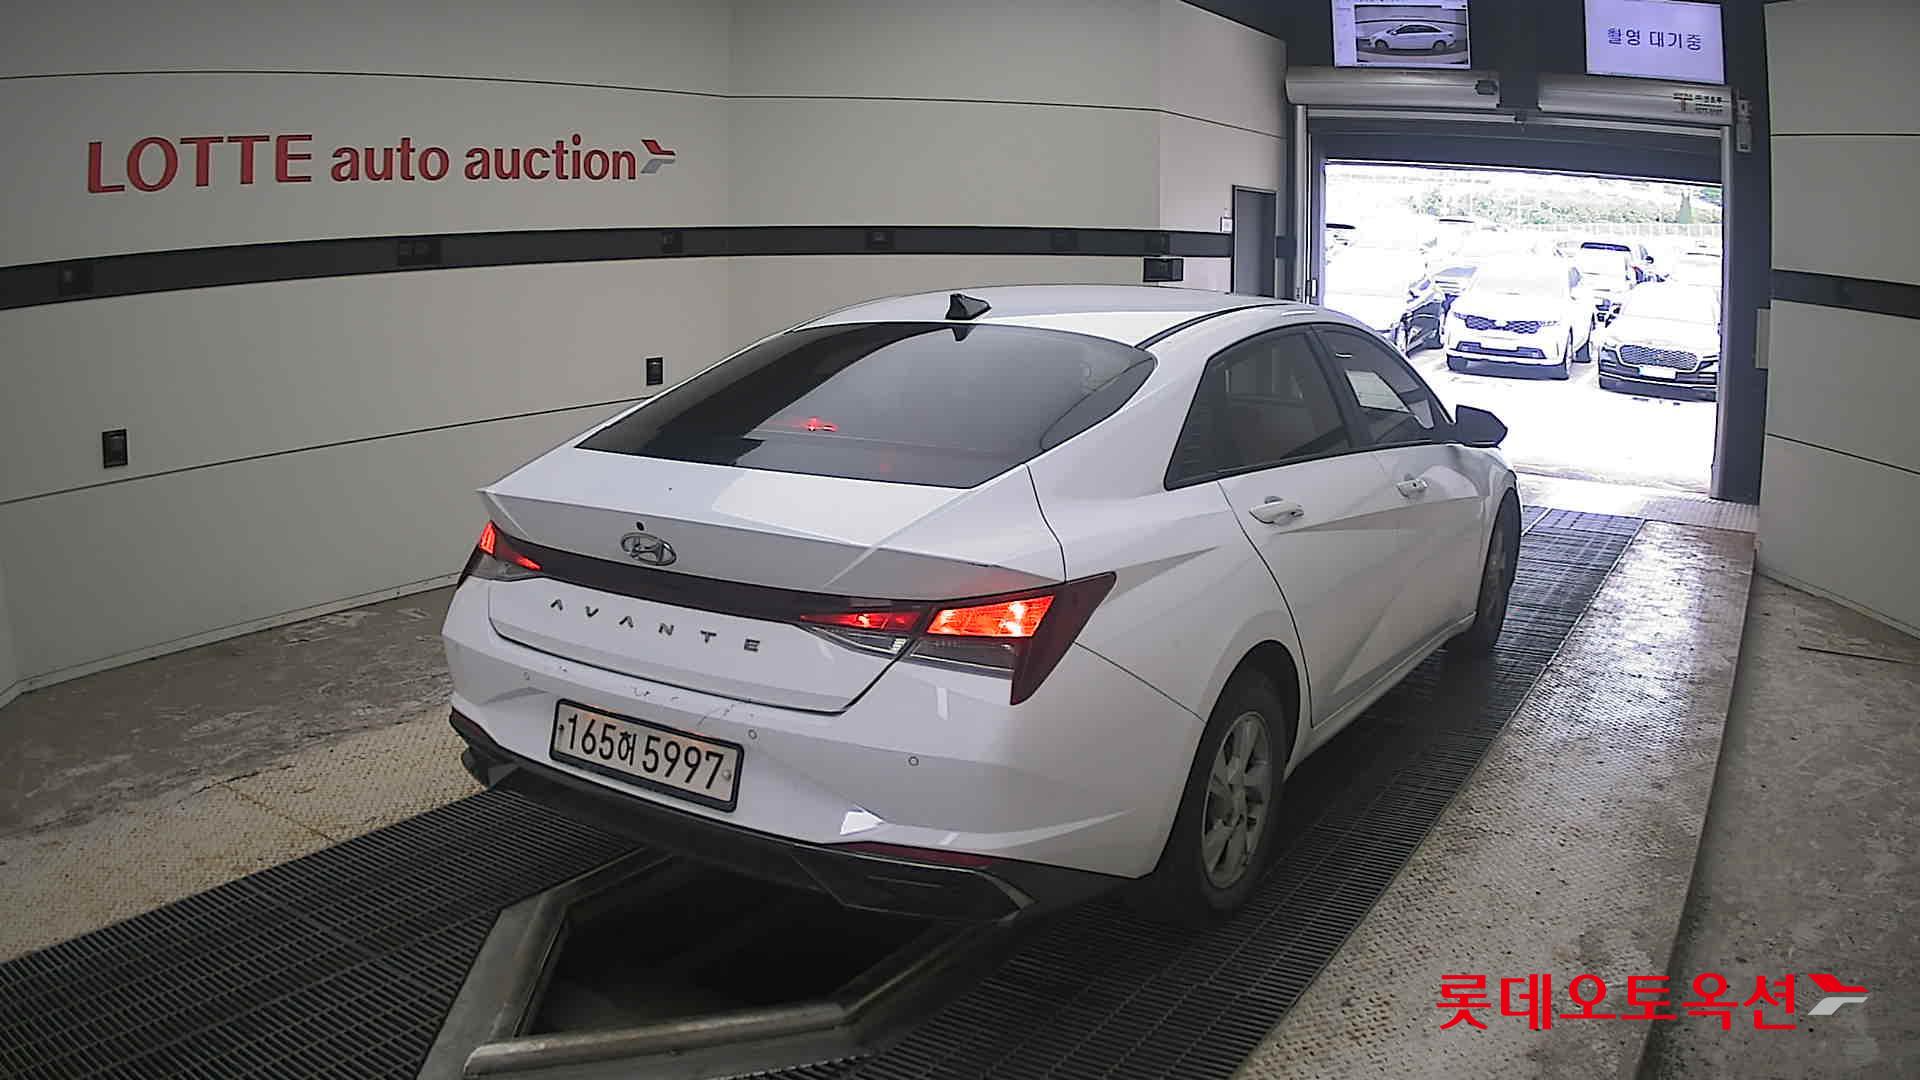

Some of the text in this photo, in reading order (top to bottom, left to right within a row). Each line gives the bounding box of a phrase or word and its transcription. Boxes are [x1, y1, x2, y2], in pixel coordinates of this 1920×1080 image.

[1649, 31, 1701, 51] 대기중
[87, 133, 637, 194] LOTTE auto auction
[550, 599, 761, 653] AVANTE
